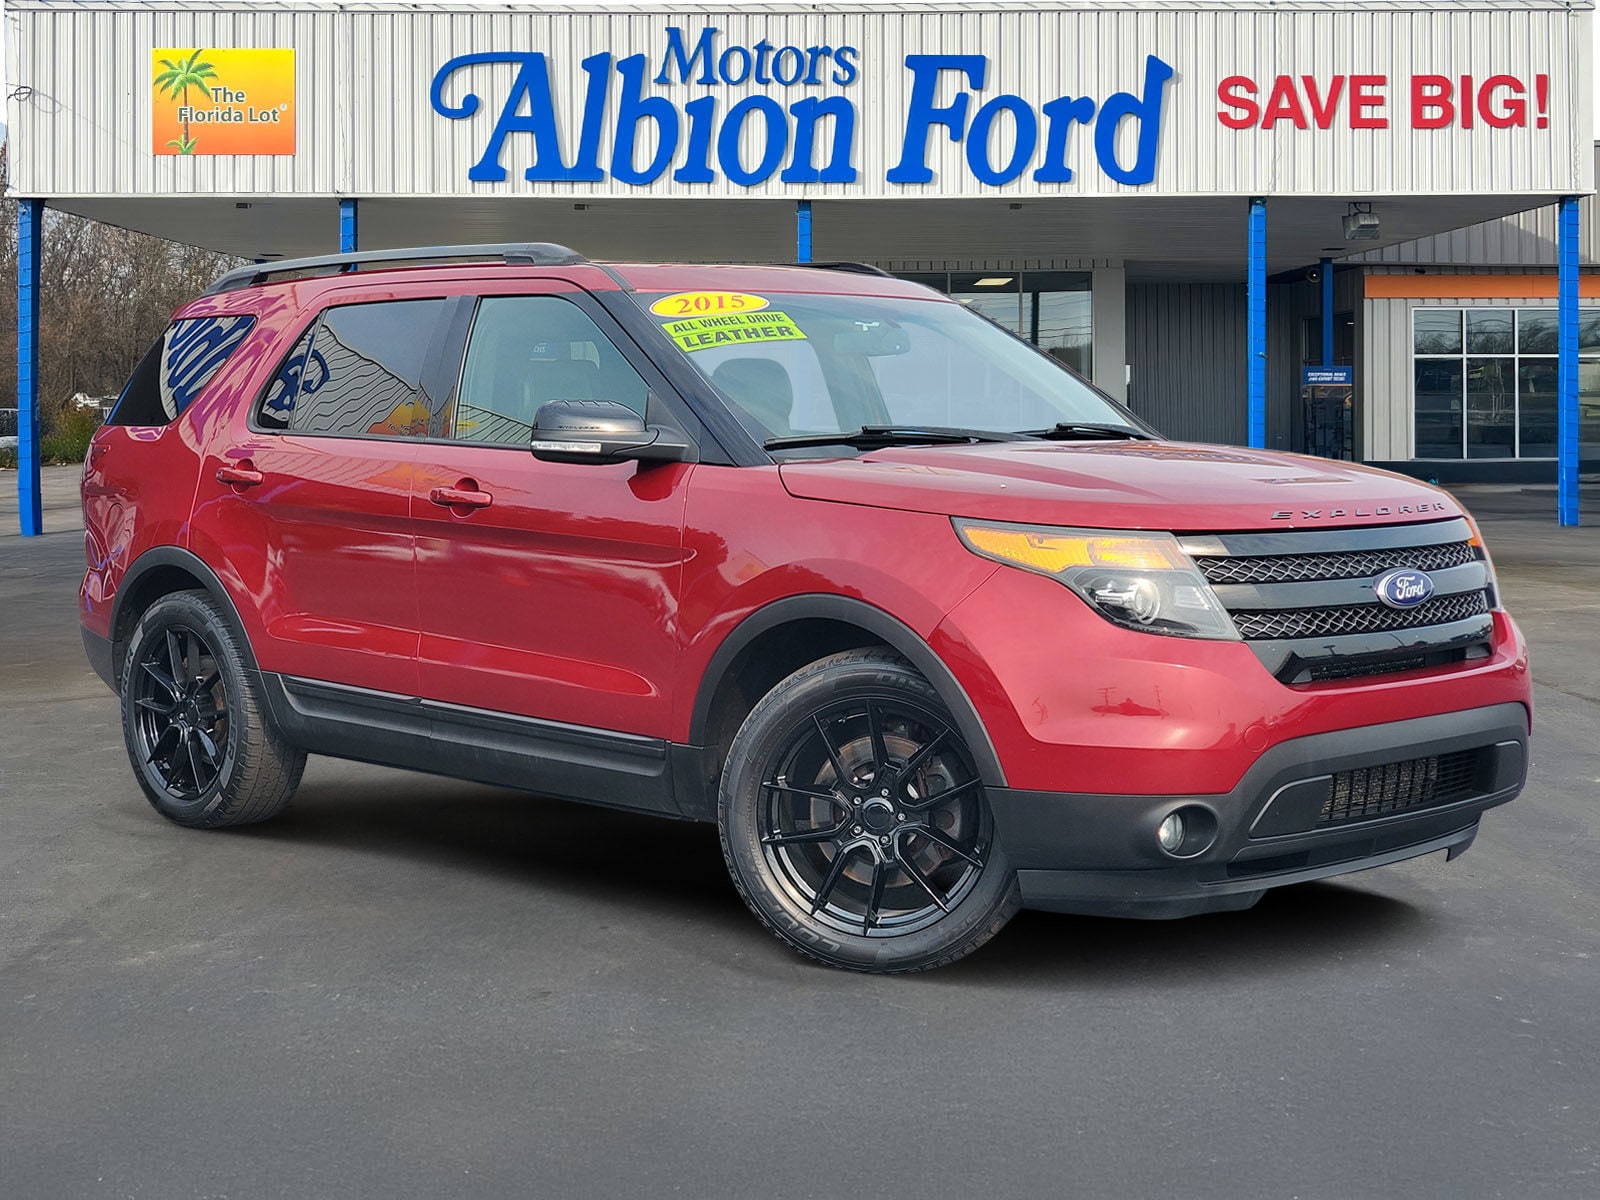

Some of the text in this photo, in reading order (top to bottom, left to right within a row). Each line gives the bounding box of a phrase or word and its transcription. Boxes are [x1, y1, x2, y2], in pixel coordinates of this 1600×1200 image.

[653, 27, 859, 86] Motors
[211, 86, 246, 103] The
[1217, 74, 1549, 130] SAVE BIG!
[178, 107, 279, 123] Florida Lot
[430, 51, 1174, 187] Albion Ford
[675, 295, 745, 314] 2015
[673, 313, 785, 334] ALL WHEEL DRIVE
[683, 325, 795, 348] LEATHER
[1270, 502, 1446, 520] EXPLORER
[1396, 576, 1426, 599] Ford
